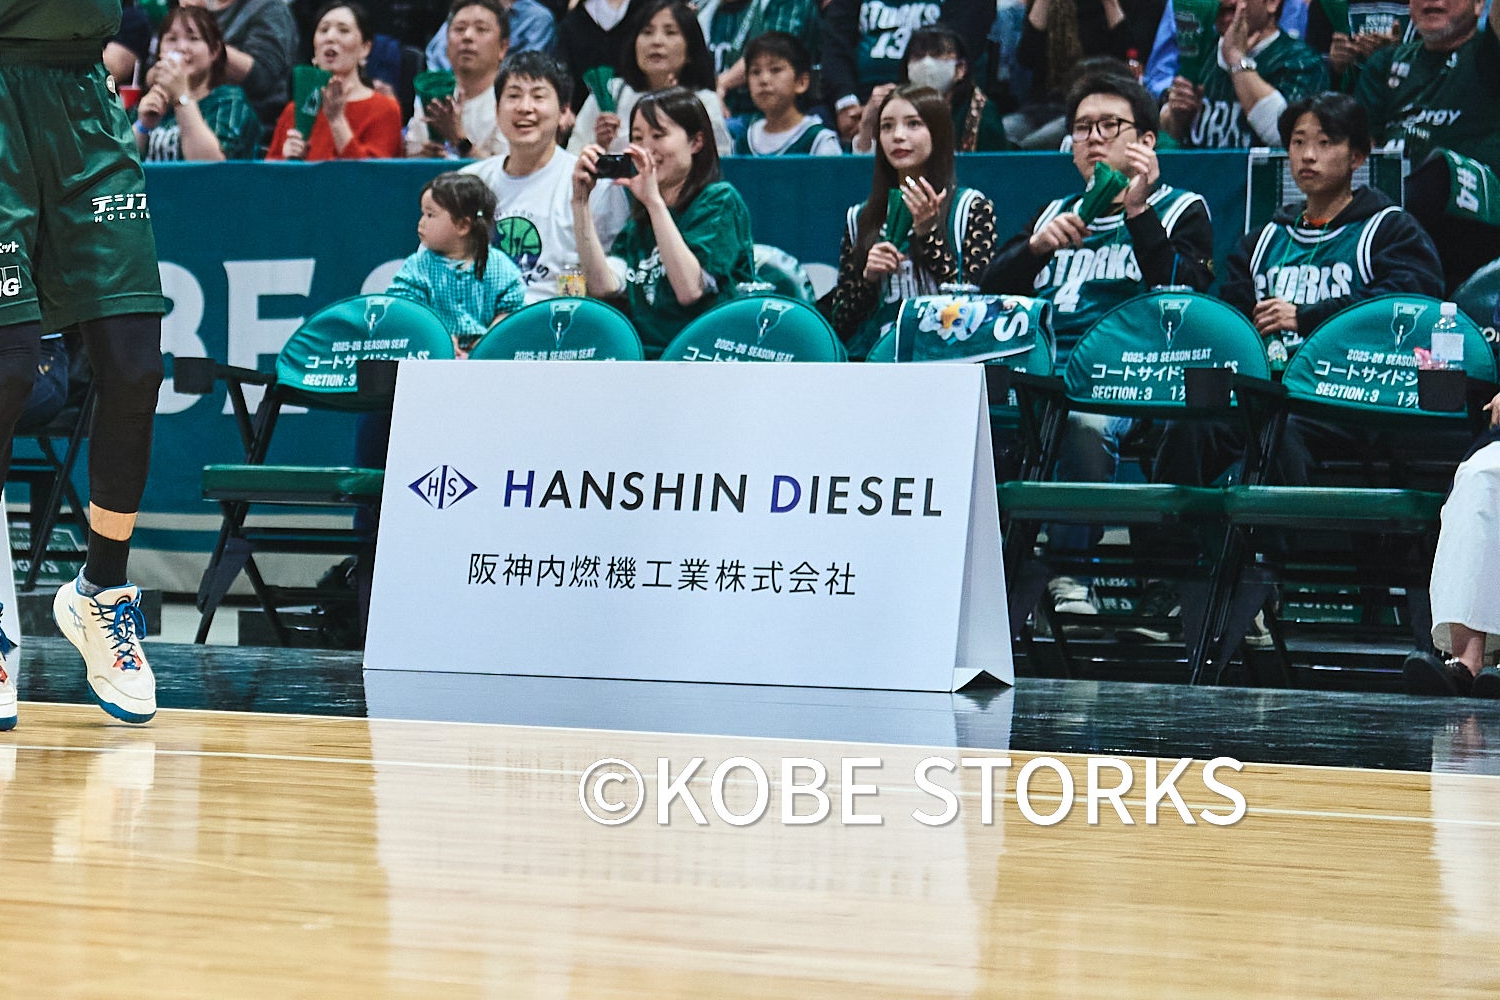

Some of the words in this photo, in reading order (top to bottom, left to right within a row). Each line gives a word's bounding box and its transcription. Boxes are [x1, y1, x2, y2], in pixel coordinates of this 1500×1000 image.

[1159, 350, 1191, 363] SEASON
[1191, 348, 1212, 361] SEAT
[503, 469, 748, 513] HANSHIN
[770, 474, 942, 517] DIESEL
[467, 552, 856, 597] 阪神内燃機工業株式会社
